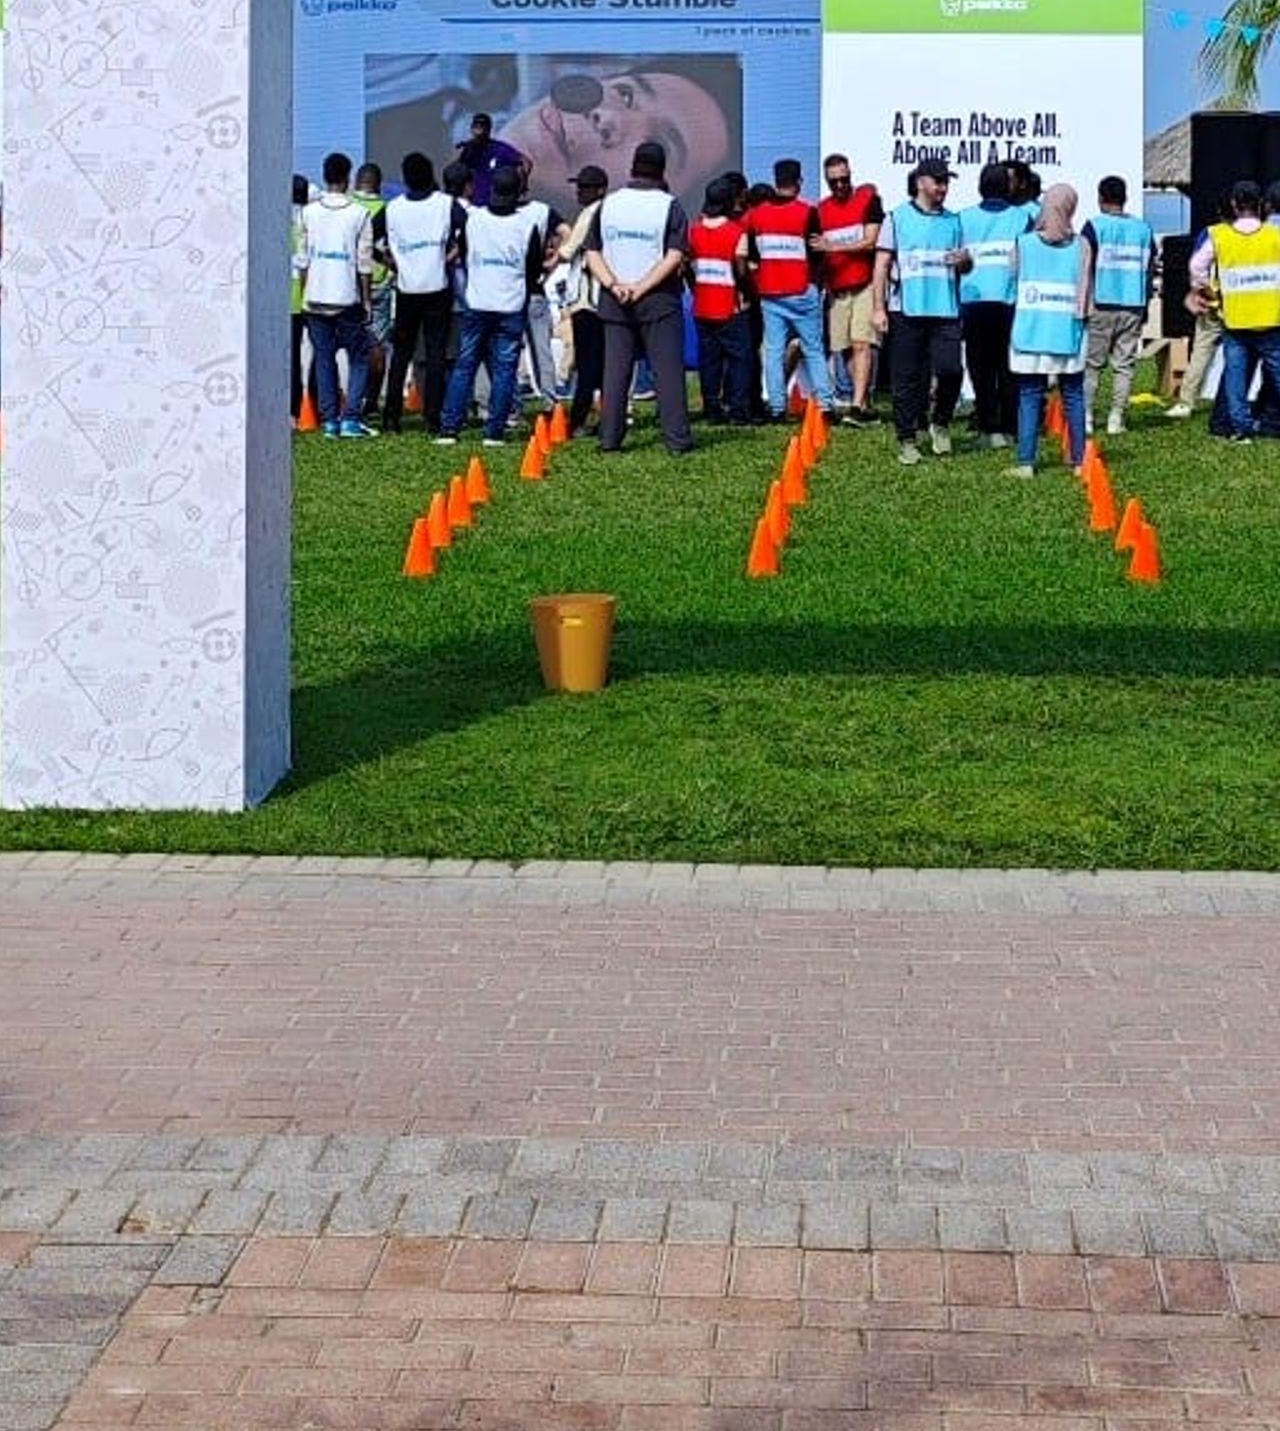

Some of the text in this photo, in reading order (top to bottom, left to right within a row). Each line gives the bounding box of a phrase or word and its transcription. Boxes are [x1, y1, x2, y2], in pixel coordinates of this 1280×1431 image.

[892, 111, 1061, 138] A Team Above All.
[892, 140, 1061, 166] Above All A Team.
